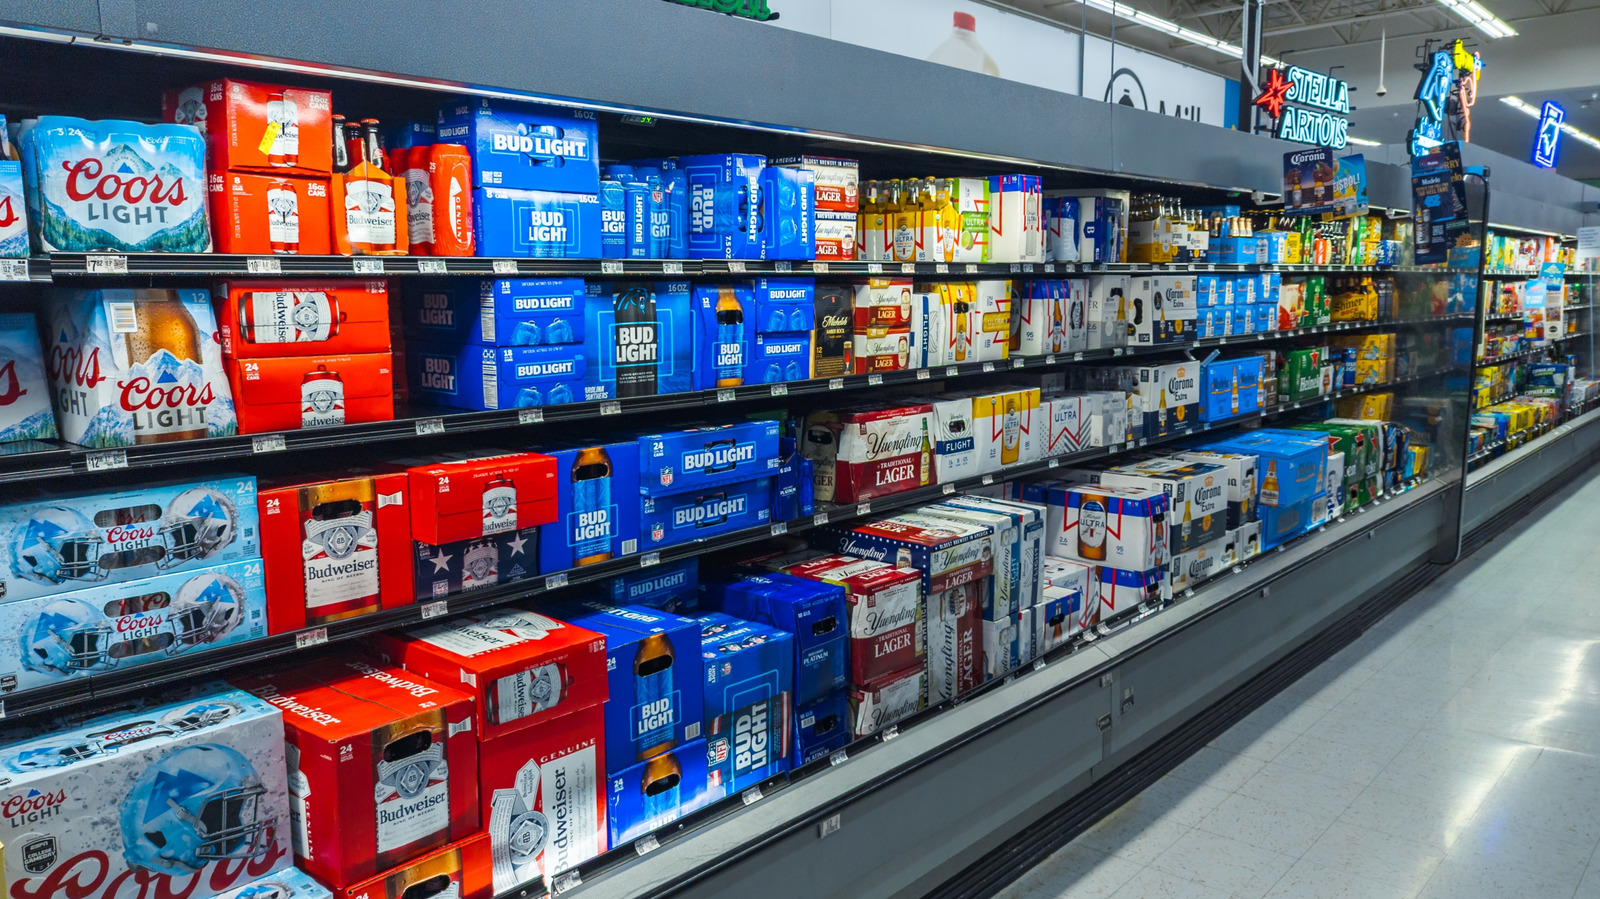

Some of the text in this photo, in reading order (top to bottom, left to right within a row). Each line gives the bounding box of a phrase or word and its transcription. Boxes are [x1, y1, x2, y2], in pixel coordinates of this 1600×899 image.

[1286, 66, 1349, 114] STELLA
[309, 102, 329, 110] CANS
[440, 127, 452, 138] BUD
[1280, 107, 1348, 149] ARTOIS
[494, 134, 587, 158] BUD LIGHT
[1291, 152, 1325, 166] Corona
[62, 158, 188, 206] Coors
[210, 184, 223, 192] CANS
[816, 191, 841, 202] LAGER
[88, 203, 168, 226] LIGHT
[692, 184, 703, 234] LIGHT
[702, 188, 713, 229] BUD
[749, 176, 758, 242] BUD LIGHT
[349, 214, 392, 227] Budweiser
[531, 211, 564, 227] BUD
[966, 218, 985, 226] ULTRA
[528, 226, 567, 242] LIGHT
[191, 292, 206, 303] 12
[424, 294, 448, 308] BUD
[770, 289, 806, 299] BUD LIGHT
[515, 297, 572, 310] BUD LIGHT
[420, 309, 453, 326] LIGHT
[877, 310, 896, 319] LAGER
[619, 327, 654, 345] BUD
[616, 344, 657, 362] LIGHT
[720, 344, 740, 355] BUD
[766, 343, 801, 354] BUD LIGHT
[245, 363, 259, 372] 24
[426, 358, 450, 373] BUD
[718, 354, 743, 366] LIGHT
[875, 359, 893, 368] LAGER
[518, 362, 573, 377] BUD LIGHT
[422, 373, 454, 390] LIGHT
[1169, 377, 1194, 395] Corona
[117, 377, 216, 411] Coors
[1174, 392, 1188, 401] Extra
[132, 407, 208, 430] LIGHT
[1055, 410, 1077, 422] ULTRA
[653, 441, 664, 451] 24
[866, 432, 922, 460] Yuengling
[946, 440, 971, 452] FLIGHT
[685, 445, 754, 470] BUD LIGHT
[881, 458, 911, 469] TRADITIONAL
[439, 477, 450, 485] 24
[876, 464, 915, 486] LAGER
[237, 481, 254, 493] 24
[1195, 484, 1222, 505] Corona
[266, 499, 280, 508] 24
[645, 499, 655, 507] 24
[1200, 502, 1215, 513] Extra
[579, 510, 607, 526] BUD
[676, 498, 745, 526] BUD LIGHT
[575, 522, 611, 542] LIGHT
[1080, 518, 1106, 530] ULTRA
[106, 526, 155, 544] Coors
[974, 530, 989, 539] AMERICA
[113, 538, 151, 552] LIGHT
[838, 537, 888, 561] Yuengling
[939, 544, 980, 571] Yuengling
[244, 565, 261, 577] 24
[308, 557, 376, 580] Budweiser
[949, 566, 972, 578] TRADITIONAL
[630, 572, 684, 597] BUD LIGHT
[945, 571, 974, 590] LAGER
[116, 613, 163, 633] Coors
[864, 606, 916, 636] Yuengling
[123, 626, 160, 641] LIGHT
[879, 627, 908, 642] TRADITIONAL
[875, 633, 911, 658] LAGER
[607, 657, 616, 666] 24
[803, 651, 829, 665] PLATINUM
[251, 683, 341, 727] Budweiser
[642, 698, 670, 719] BUD
[639, 709, 674, 734] LIGHT
[869, 700, 919, 731] Yuengling
[104, 725, 153, 741] Coors
[751, 702, 767, 770] LIGHT
[340, 743, 353, 755] 24
[540, 738, 596, 763] GENUINE
[736, 714, 752, 771] BUD
[716, 740, 726, 762] NFL
[613, 779, 624, 788] 24
[1, 789, 67, 818] Coors
[379, 791, 446, 825] Budweiser
[11, 804, 62, 829] LIGHT
[552, 766, 569, 876] Budweiser
